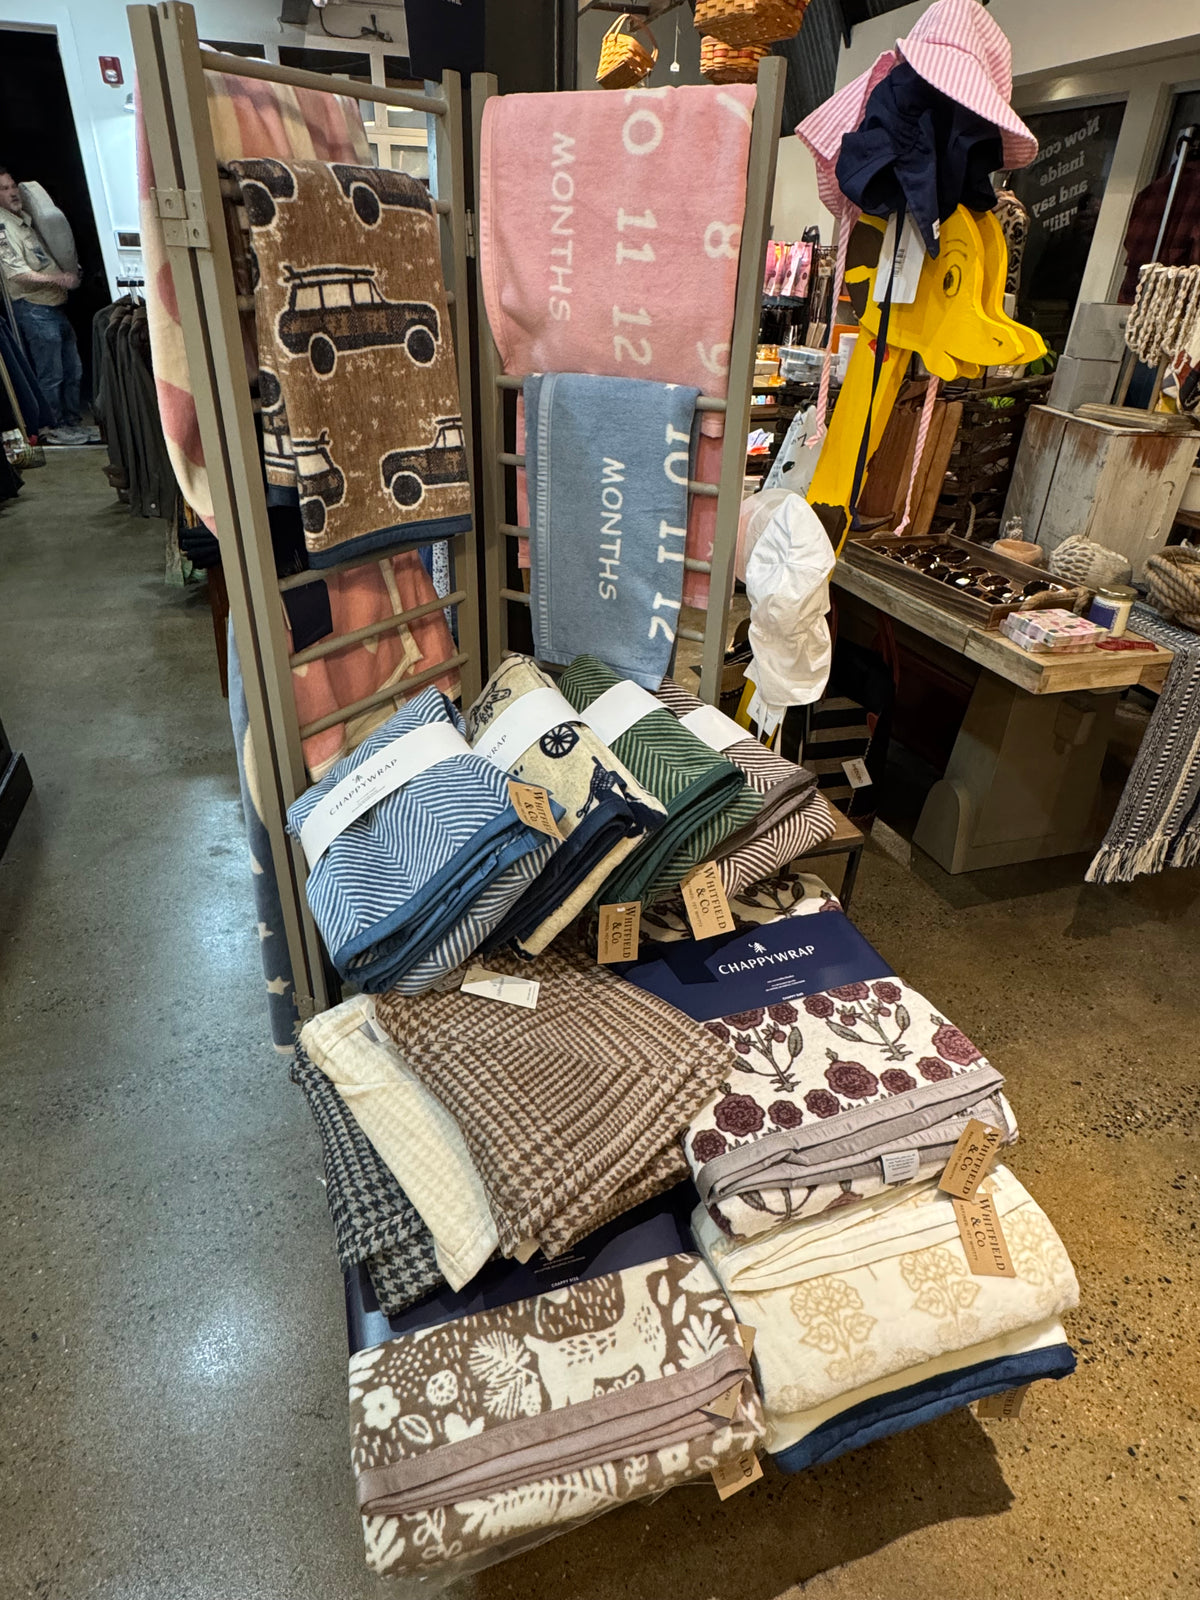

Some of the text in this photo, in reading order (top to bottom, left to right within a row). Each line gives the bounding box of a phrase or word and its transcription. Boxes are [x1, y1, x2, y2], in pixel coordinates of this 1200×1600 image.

[550, 131, 576, 322] MONTHS
[612, 88, 667, 365] 10 11 12
[704, 221, 742, 259] 8
[598, 457, 626, 600] MONTHS
[329, 758, 398, 816] CHAPPYWRAP
[524, 801, 534, 810] &
[696, 887, 706, 898] &
[704, 866, 727, 929] WHITFIELD
[612, 921, 622, 931] &
[622, 905, 636, 959] WHITFIELD
[718, 945, 816, 975] CHAPPYWRAP
[962, 1133, 999, 1195] WHITFIELD
[967, 1144, 979, 1154] &
[970, 1216, 981, 1226] &
[979, 1198, 1006, 1271] WHITFIELD
